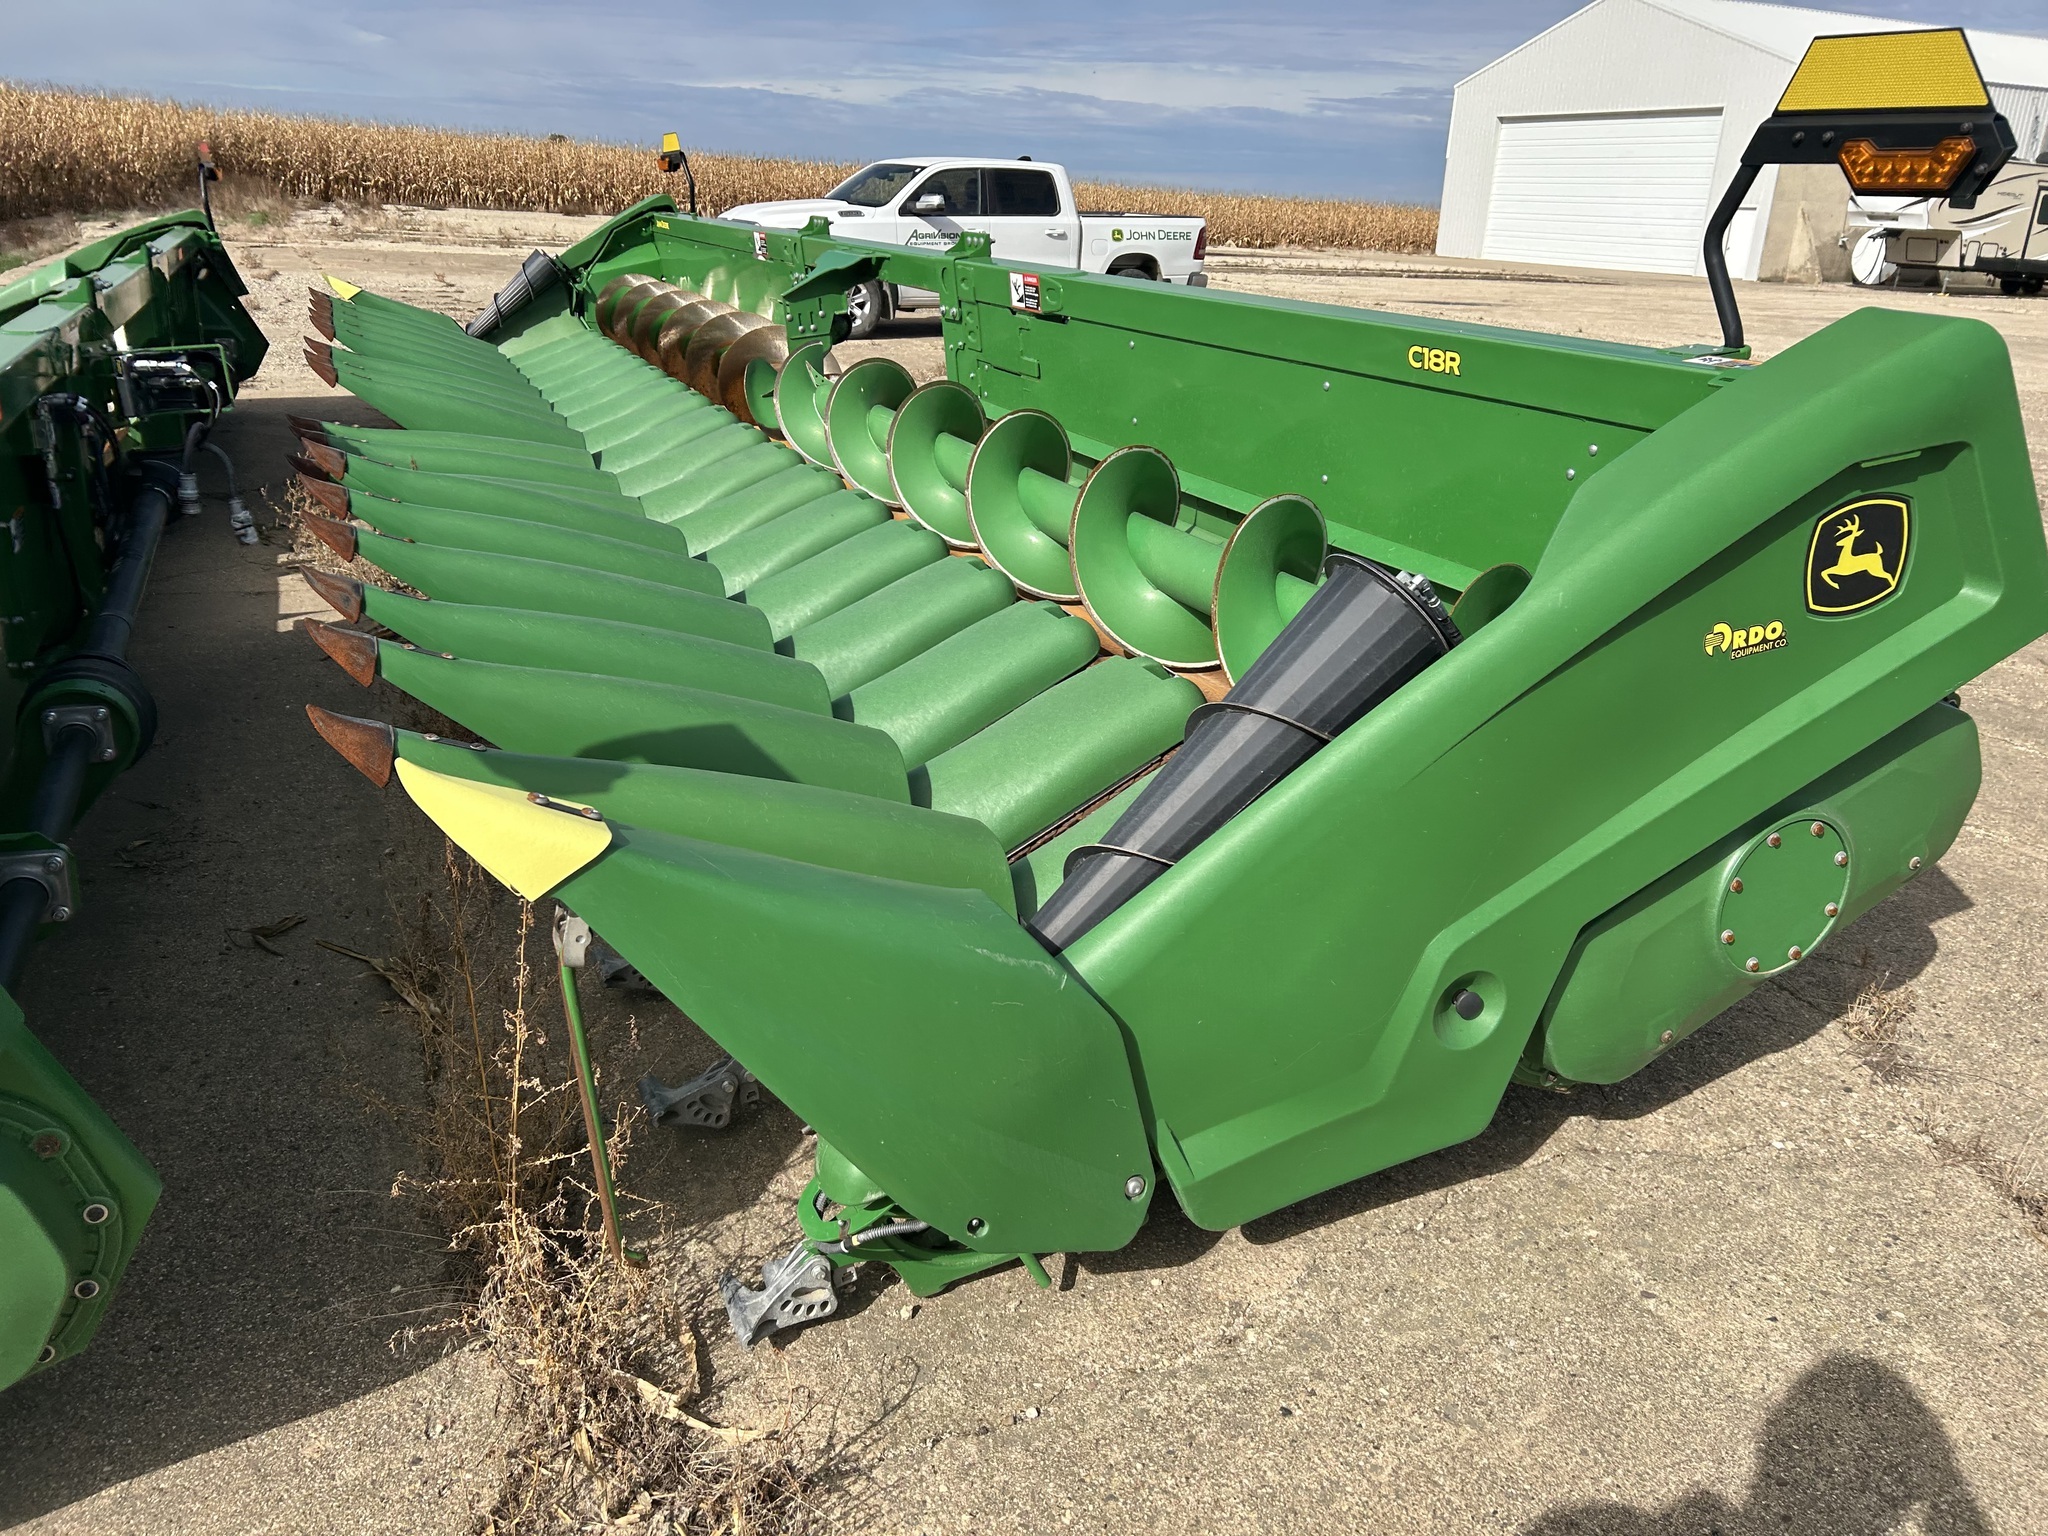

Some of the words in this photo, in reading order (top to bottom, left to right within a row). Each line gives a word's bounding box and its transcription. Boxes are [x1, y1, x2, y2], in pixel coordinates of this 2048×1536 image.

[1126, 229, 1156, 241] JOHN
[1157, 229, 1192, 241] DEERE
[1408, 345, 1461, 376] C18R
[1731, 641, 1774, 660] EQUIPMENT
